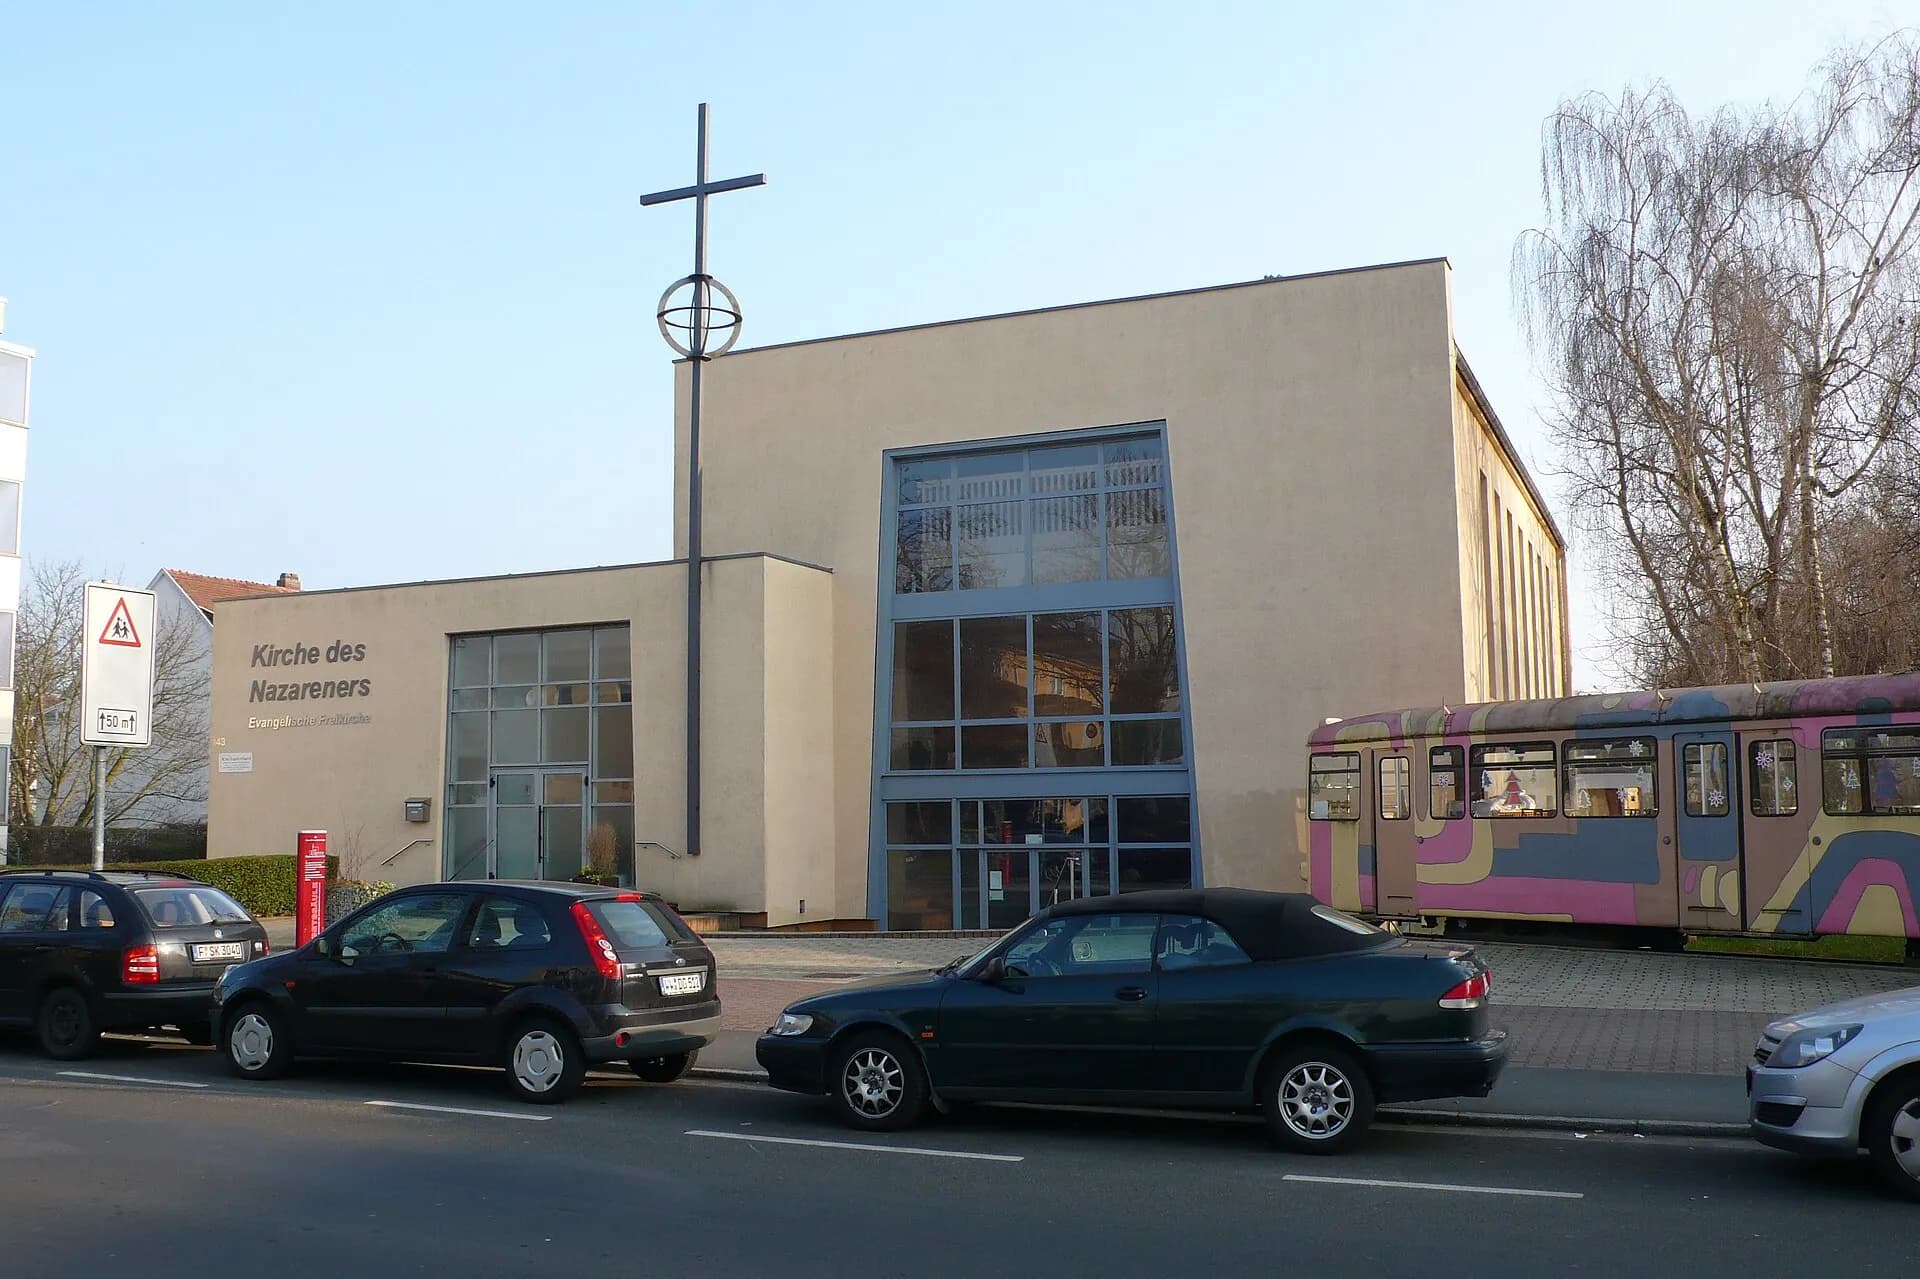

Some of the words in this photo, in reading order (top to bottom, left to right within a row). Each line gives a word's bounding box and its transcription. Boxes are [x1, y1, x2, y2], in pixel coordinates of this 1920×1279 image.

[251, 642, 320, 668] Kirche
[326, 639, 366, 663] des
[249, 677, 371, 703] Nazareners
[106, 715, 118, 728] 50
[121, 719, 129, 728] m
[248, 714, 316, 730] Evangelische
